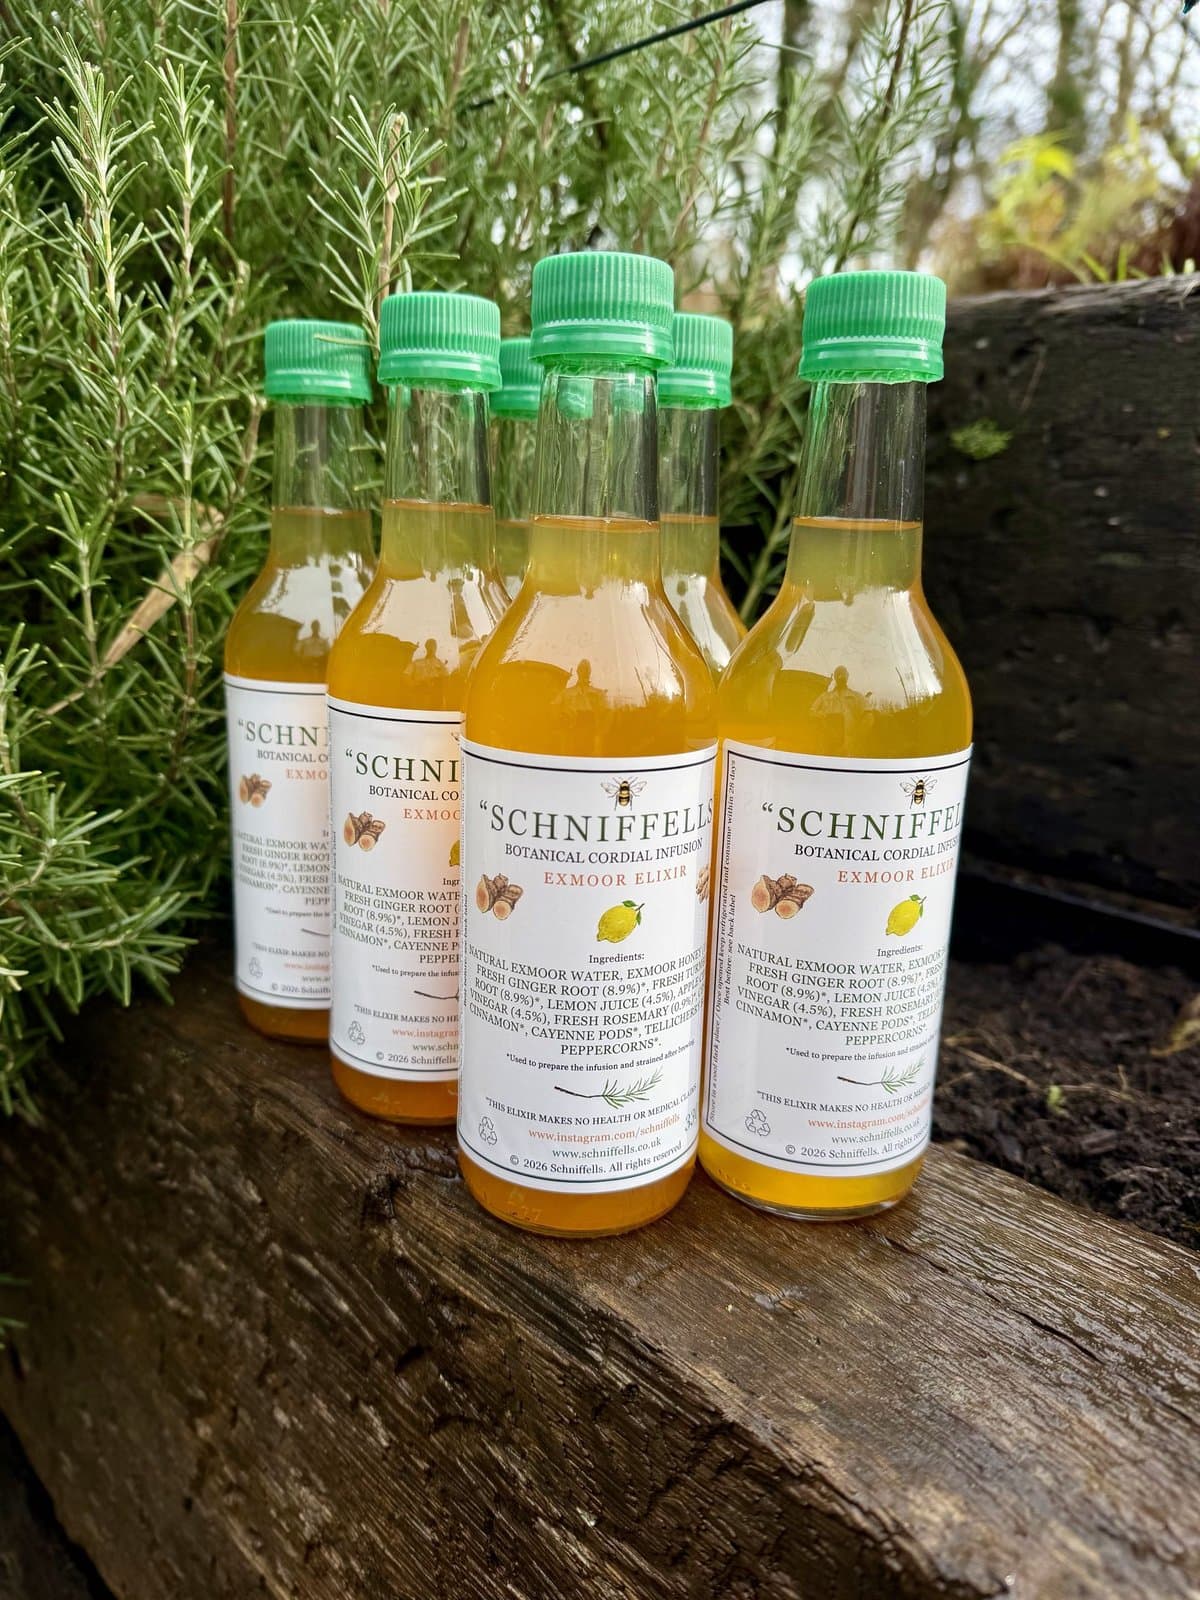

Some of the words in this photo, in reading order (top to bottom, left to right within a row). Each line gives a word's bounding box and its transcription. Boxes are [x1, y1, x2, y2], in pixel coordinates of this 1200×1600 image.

[257, 750, 315, 762] BOTANICAL
[345, 748, 460, 783] “SCHNI
[369, 785, 438, 800] BOTANICAL
[265, 850, 299, 861] GINGER
[267, 839, 306, 850] EXMOOR
[505, 843, 584, 863] BOTANICAL
[589, 847, 652, 864] CORDIAL
[656, 838, 702, 859] INFUSION
[794, 844, 879, 861] BOTANICAL
[883, 846, 935, 860] CORDIAL
[294, 864, 330, 873] LEMON
[720, 885, 728, 935] refrigerated
[729, 783, 734, 794] 28
[544, 872, 626, 887] EXMOOR
[635, 865, 687, 885] ELIXIR
[837, 870, 914, 883] EXMOOR
[282, 885, 329, 894] CAYENNE
[338, 875, 373, 894] NATURAL
[375, 888, 424, 901] EXMOOR
[345, 891, 371, 905] FRESH
[373, 900, 414, 912] GINGER
[420, 904, 452, 913] ROOT
[339, 912, 374, 932] VINEGAR
[376, 926, 410, 938] (4.5%),
[414, 929, 453, 938] FRESH
[344, 903, 364, 917] ROOT
[408, 917, 450, 925] LEMON
[394, 941, 448, 951] CAYENNE
[877, 944, 923, 957] Ingredients:
[469, 944, 508, 971] NATURAL
[512, 964, 566, 981] EXMOOR
[572, 970, 623, 981] WATER,
[628, 960, 675, 979] EXMOOR
[679, 946, 702, 970] HONEY
[590, 953, 644, 964] Ingredients:
[724, 955, 732, 984] before:
[737, 944, 792, 967] NATURAL
[796, 961, 855, 974] EXMOOR
[861, 962, 905, 974] WATER,
[400, 969, 425, 977] prepare
[477, 964, 505, 984] FRESH
[508, 977, 556, 995] GINGER
[561, 985, 598, 996] ROOT
[653, 970, 684, 989] FRESH
[749, 963, 789, 981] FRESH
[791, 971, 844, 988] GINGER
[849, 979, 885, 989] ROOT
[475, 977, 498, 996] ROOT
[548, 999, 597, 1011] LEMON
[601, 998, 638, 1012] JUICE
[642, 987, 675, 1007] (4.5%),
[678, 977, 698, 996] APPLE
[746, 976, 778, 992] ROOT
[835, 992, 881, 1003] LEMON
[884, 986, 916, 1002] JUICE
[470, 989, 508, 1015] VINEGAR
[511, 1006, 550, 1025] (4.5%),
[554, 1014, 597, 1026] FRESH
[604, 1005, 669, 1025] ROSEMARY
[737, 986, 789, 1010] VINEGAR
[793, 1001, 836, 1017] (4.5%),
[841, 1007, 882, 1017] FRESH
[886, 993, 934, 1016] ROSEMARY
[373, 1010, 398, 1021] ELIXIR
[401, 1015, 429, 1023] MAKES
[816, 1020, 877, 1031] CAYENNE
[531, 1027, 594, 1041] CAYENNE
[376, 1052, 384, 1061] ©
[388, 1053, 409, 1063] 2026
[538, 1062, 568, 1072] prepare
[586, 1062, 618, 1071] infusion
[621, 1059, 634, 1069] and
[636, 1055, 663, 1066] strained
[664, 1049, 677, 1059] after
[812, 1051, 819, 1059] to
[822, 1053, 852, 1061] prepare
[868, 1050, 895, 1060] infusion
[898, 1047, 908, 1055] and
[507, 1108, 536, 1120] ELIXIR
[539, 1114, 573, 1125] MAKES
[575, 1116, 589, 1125] NO
[593, 1113, 631, 1125] HEALTH
[633, 1111, 645, 1121] OR
[648, 1097, 680, 1116] MEDICAL
[784, 1098, 817, 1110] ELIXIR
[820, 1102, 852, 1113] MAKES
[855, 1102, 869, 1112] NO
[871, 1097, 902, 1111] HEALTH
[528, 1114, 680, 1144] www.instagram.com/schniffells
[510, 1155, 519, 1165] ©
[524, 1159, 547, 1171] 2026
[550, 1163, 606, 1174] Schniffells.
[610, 1160, 622, 1171] All
[625, 1155, 651, 1170] rights
[653, 1141, 682, 1162] reserved
[552, 1138, 661, 1158] www.schniffells.co.uk
[785, 1145, 796, 1155] ©
[801, 1146, 826, 1158] 2026
[828, 1147, 879, 1159] Schniffells.
[882, 1143, 894, 1154] All
